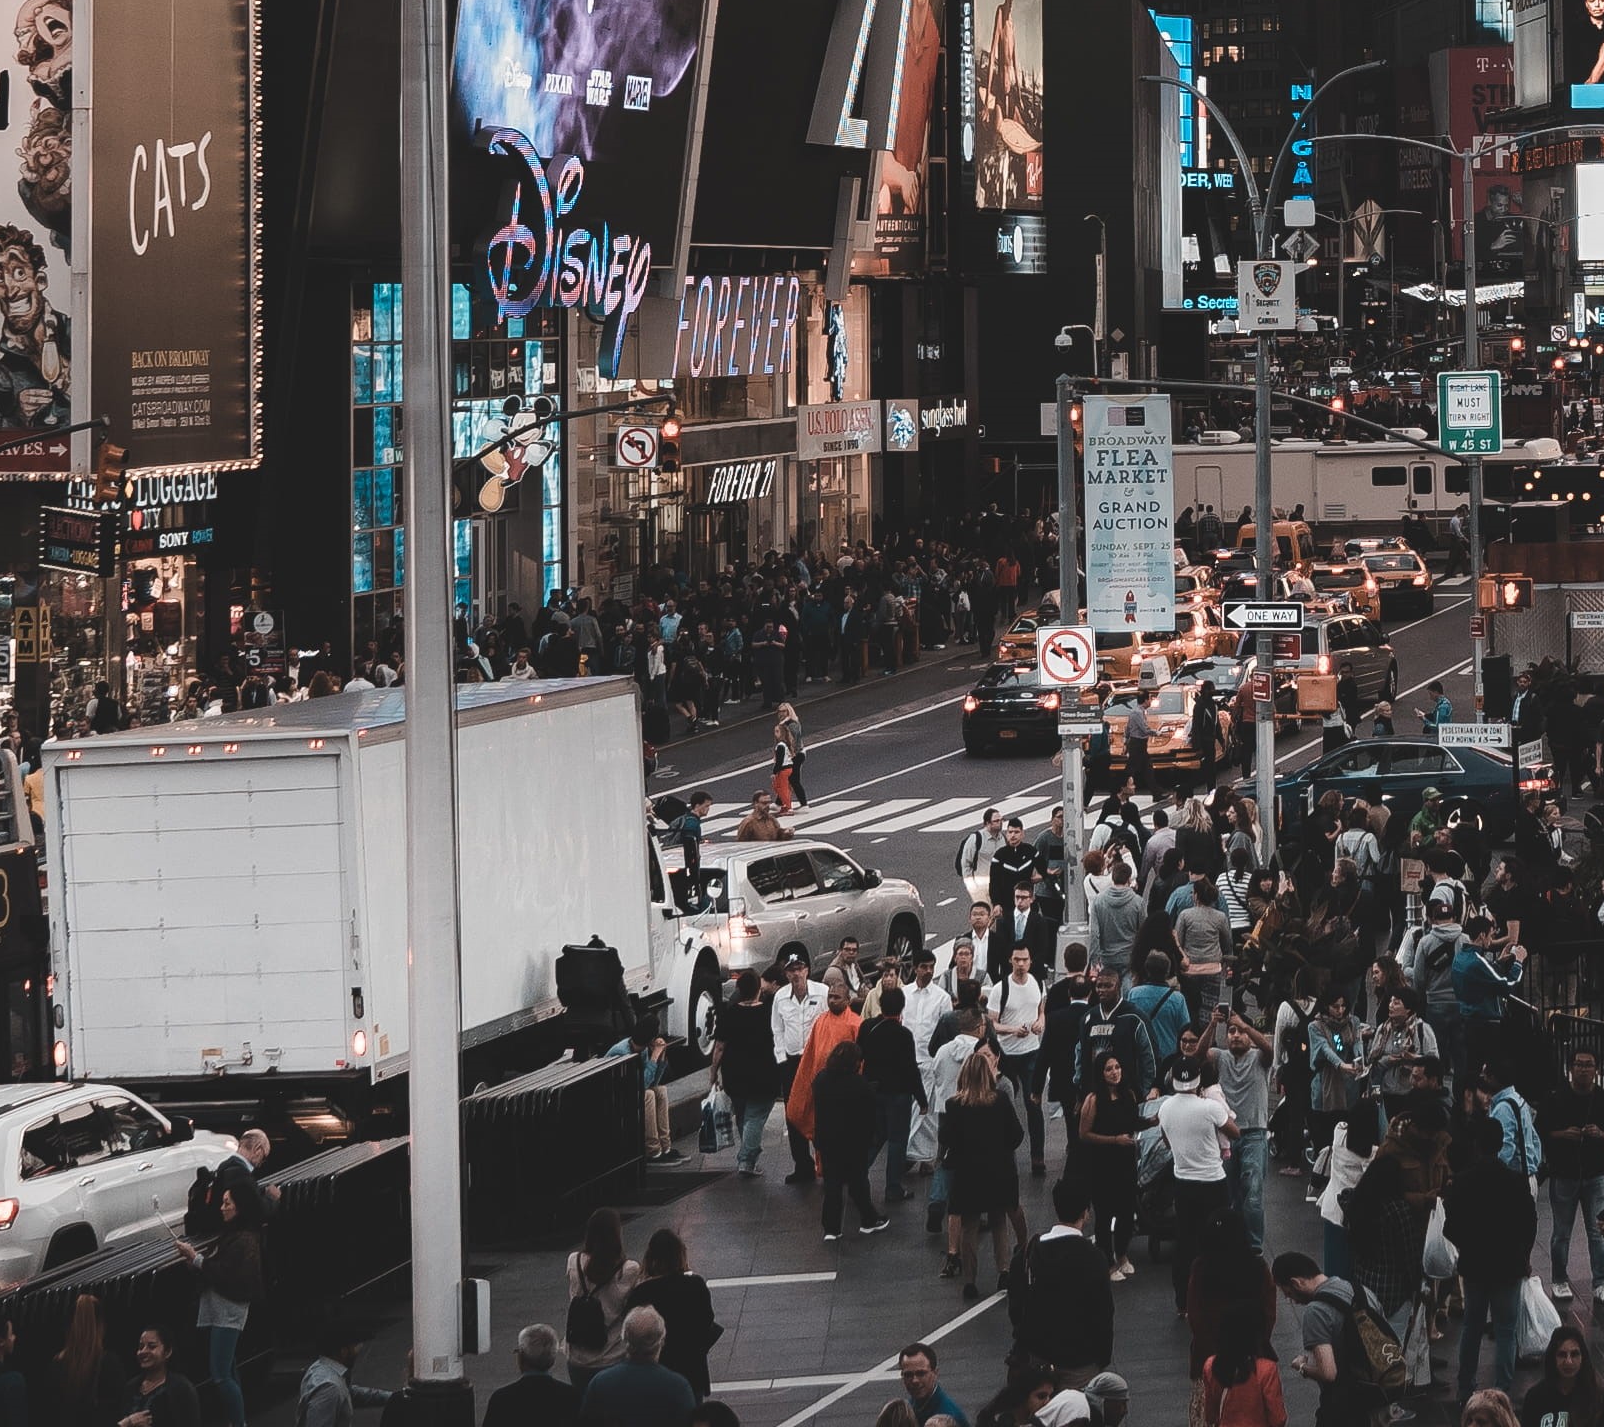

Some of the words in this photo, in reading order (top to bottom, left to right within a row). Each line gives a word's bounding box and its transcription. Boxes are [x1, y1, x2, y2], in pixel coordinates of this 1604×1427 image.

[544, 73, 573, 95] PIXAR
[129, 130, 213, 257] CATS
[673, 275, 800, 378] FOREVER
[168, 349, 211, 367] BROADWAY
[1457, 397, 1481, 408] MUST
[1089, 435, 1167, 447] BROADWAY
[1097, 449, 1159, 467] FLEA
[1087, 468, 1168, 485] MARKET
[1099, 501, 1161, 514] GRAND
[1092, 517, 1168, 531] AUCTION
[158, 532, 189, 549] SONY
[1247, 610, 1270, 621] ONE
[1272, 610, 1294, 621] WAY
